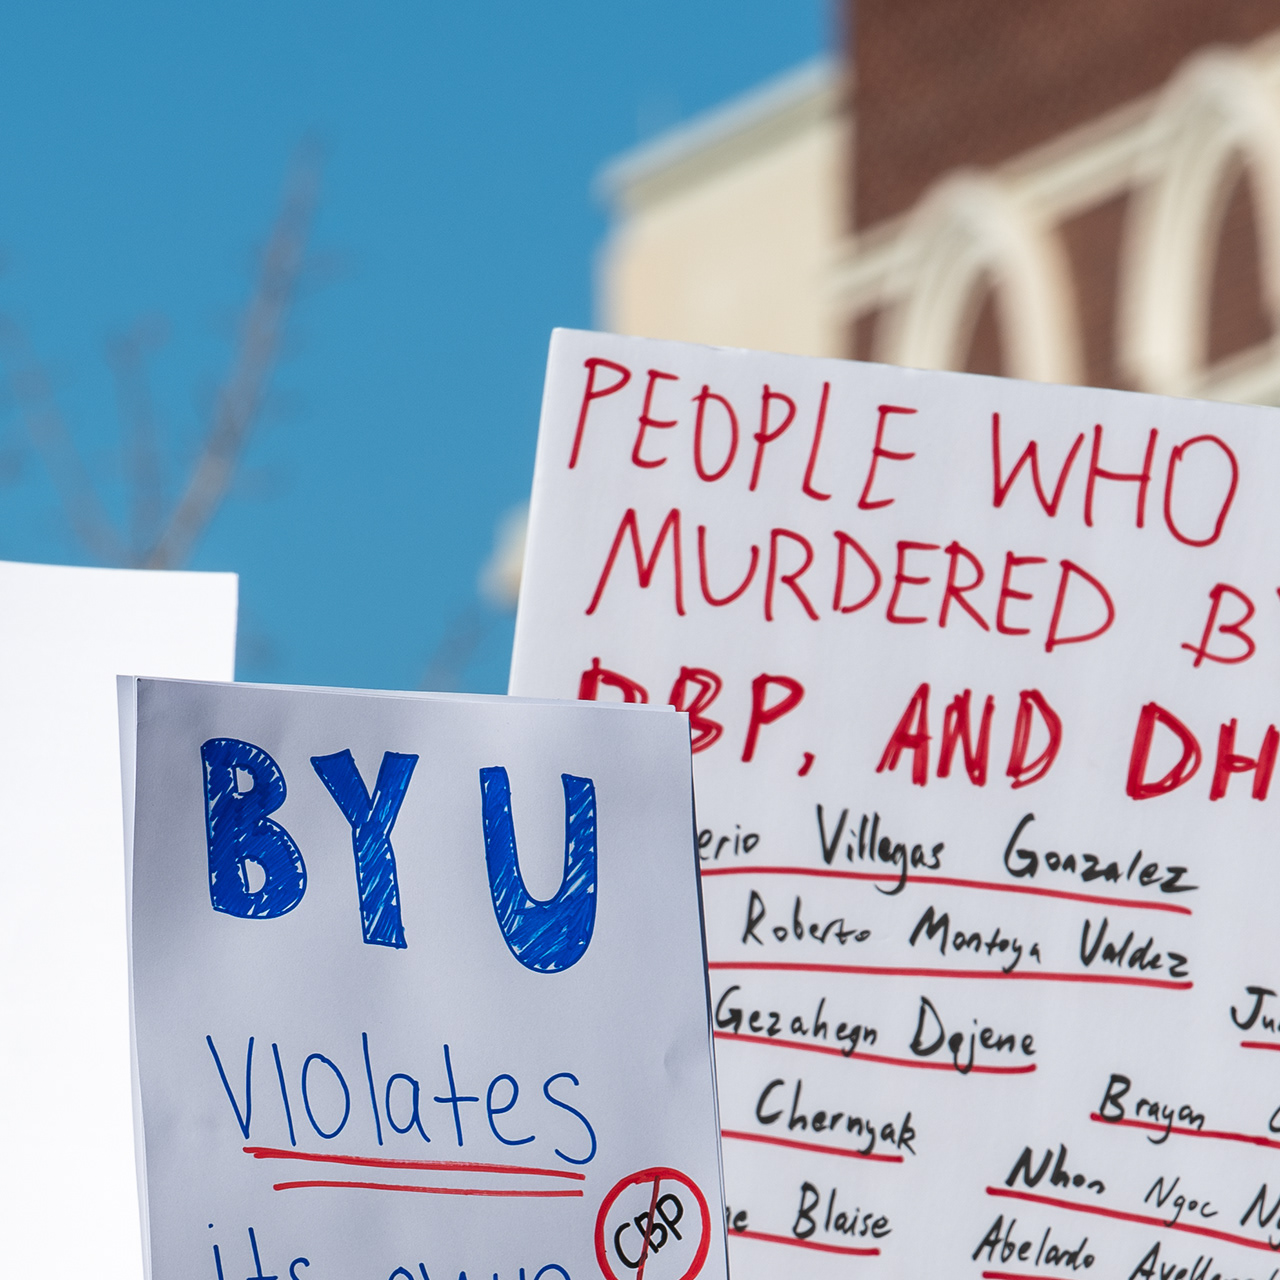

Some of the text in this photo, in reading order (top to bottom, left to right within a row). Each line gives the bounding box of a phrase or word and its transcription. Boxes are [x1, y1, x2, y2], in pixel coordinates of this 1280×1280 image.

[568, 357, 918, 510] PEOPLE
[992, 412, 1239, 547] WHO
[585, 507, 1115, 652] MURDERED
[875, 682, 1063, 789] AND
[817, 804, 945, 894] Villegas
[1004, 813, 1200, 894] Gonzalez
[741, 889, 1191, 978] Roberto Montoya Valdez
[714, 985, 879, 1057] Gezahegn
[755, 1078, 917, 1157] Chernyak
[1098, 1073, 1206, 1145] Brayan
[614, 1193, 683, 1269] CBP
[792, 1182, 893, 1240] Blaise
[1143, 1176, 1219, 1228] Ngoc
[972, 1215, 1096, 1272] Abelardo
